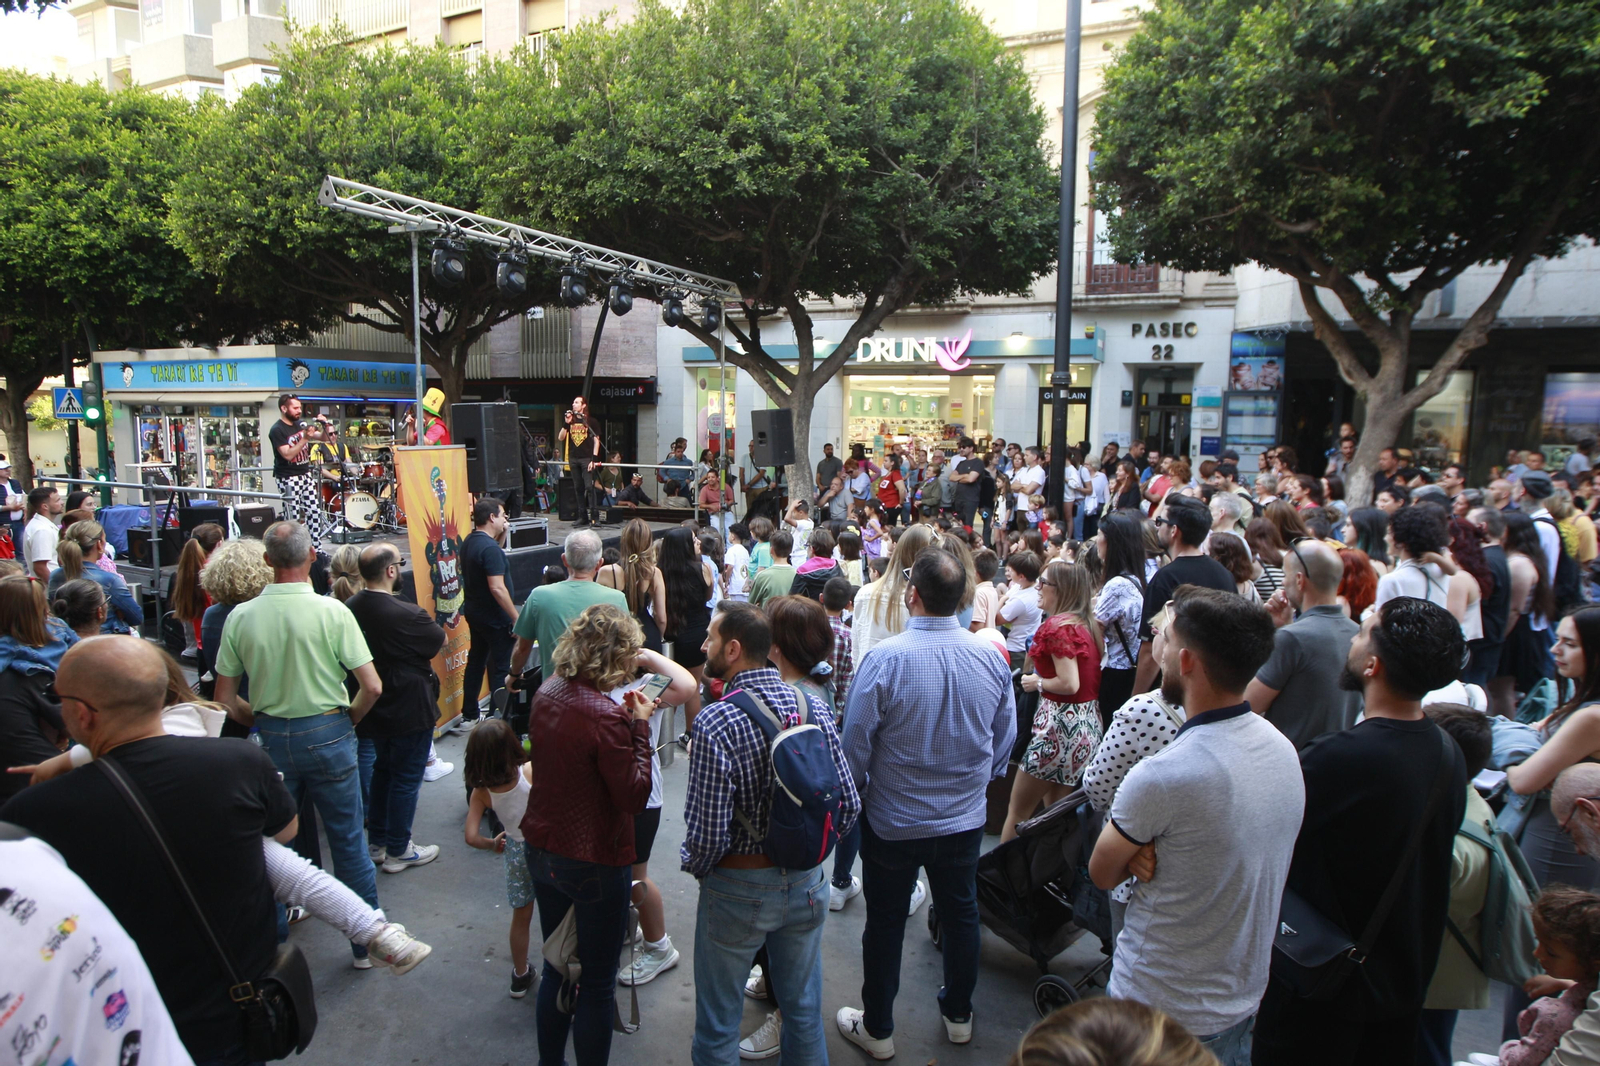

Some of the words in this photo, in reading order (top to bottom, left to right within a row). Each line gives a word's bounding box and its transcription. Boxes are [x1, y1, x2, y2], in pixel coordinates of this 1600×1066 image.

[1131, 322, 1198, 338] PASEO
[856, 337, 937, 362] DRUNI
[1152, 344, 1175, 360] 22
[189, 364, 204, 382] KE
[208, 363, 223, 382] TE
[363, 369, 377, 383] KE
[382, 370, 396, 384] TE
[600, 386, 636, 398] cajasur
